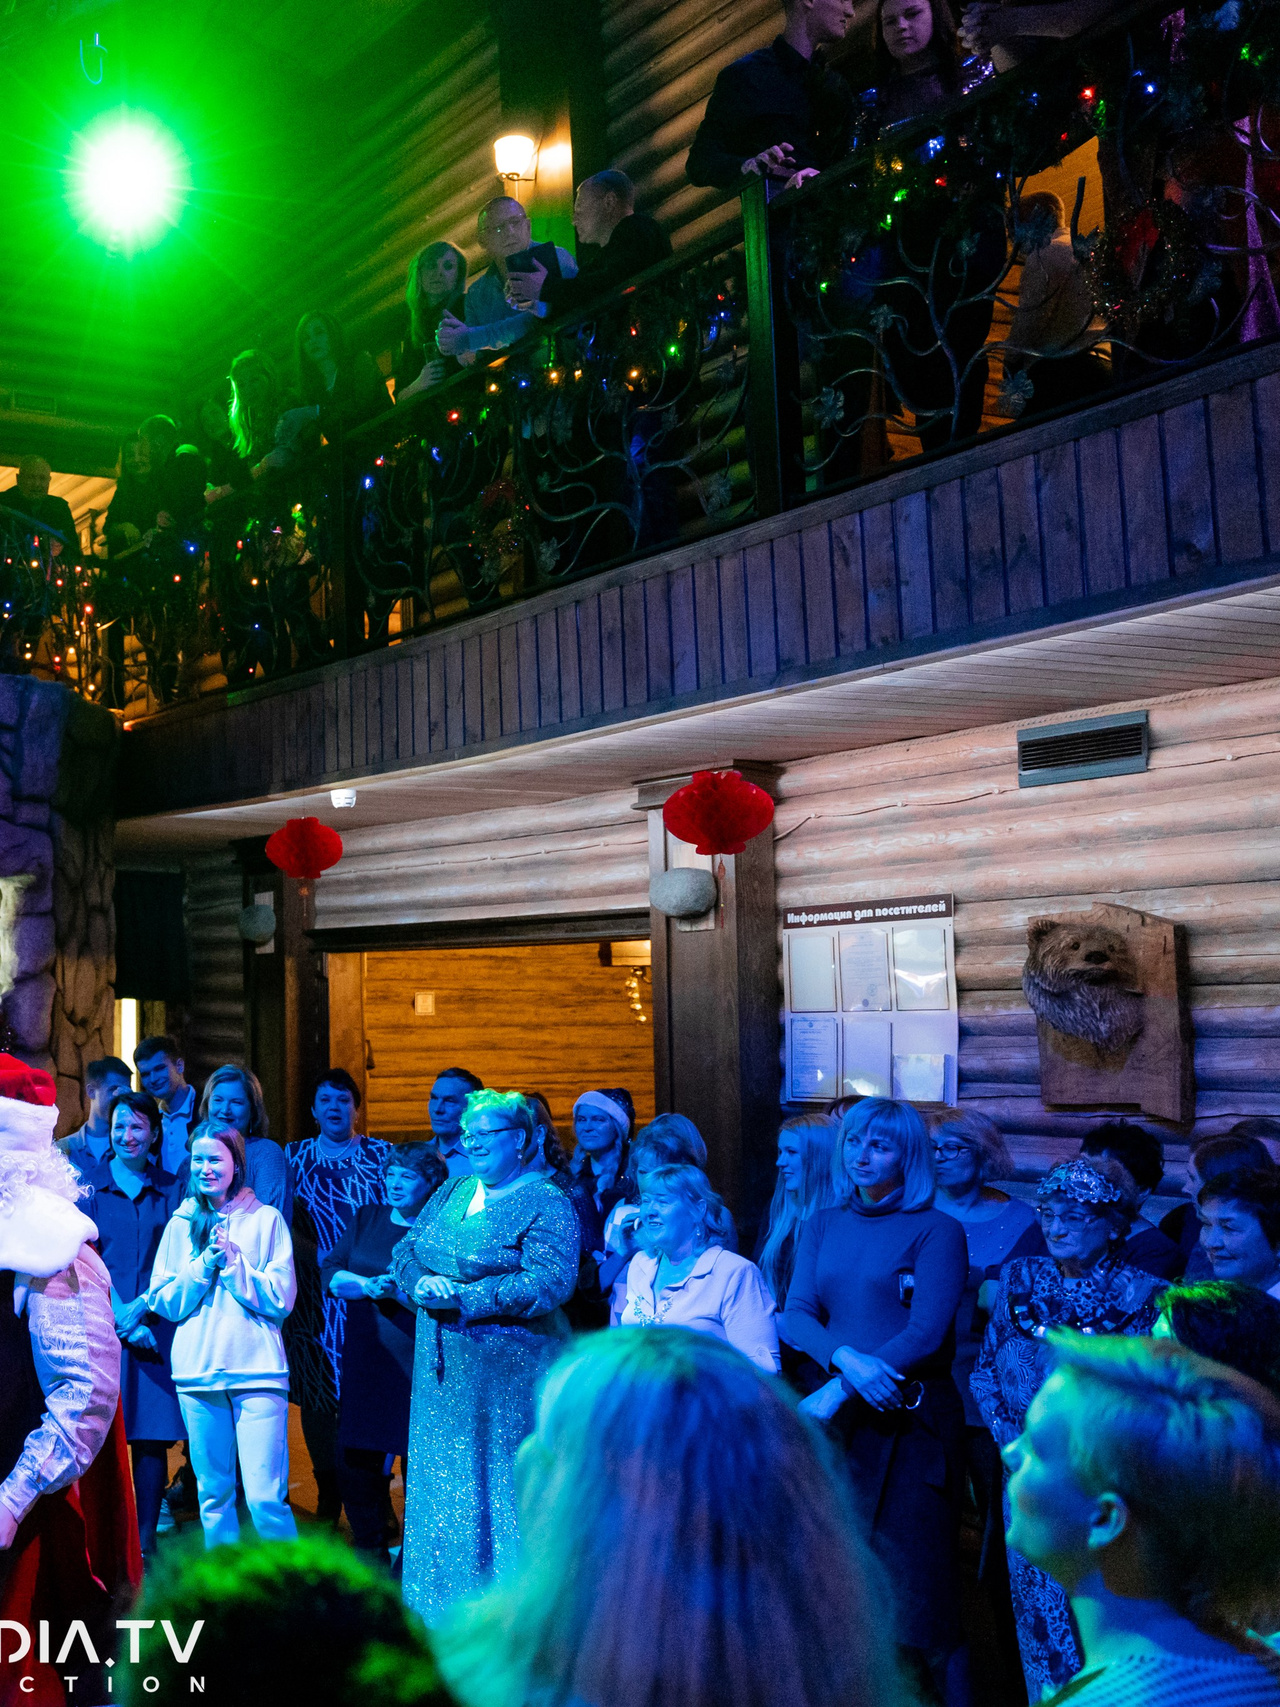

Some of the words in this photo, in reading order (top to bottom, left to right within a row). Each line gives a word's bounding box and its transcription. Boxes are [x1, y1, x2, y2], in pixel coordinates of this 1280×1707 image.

[787, 910, 852, 924] Информация
[854, 909, 873, 921] для
[875, 901, 946, 917] посетителей
